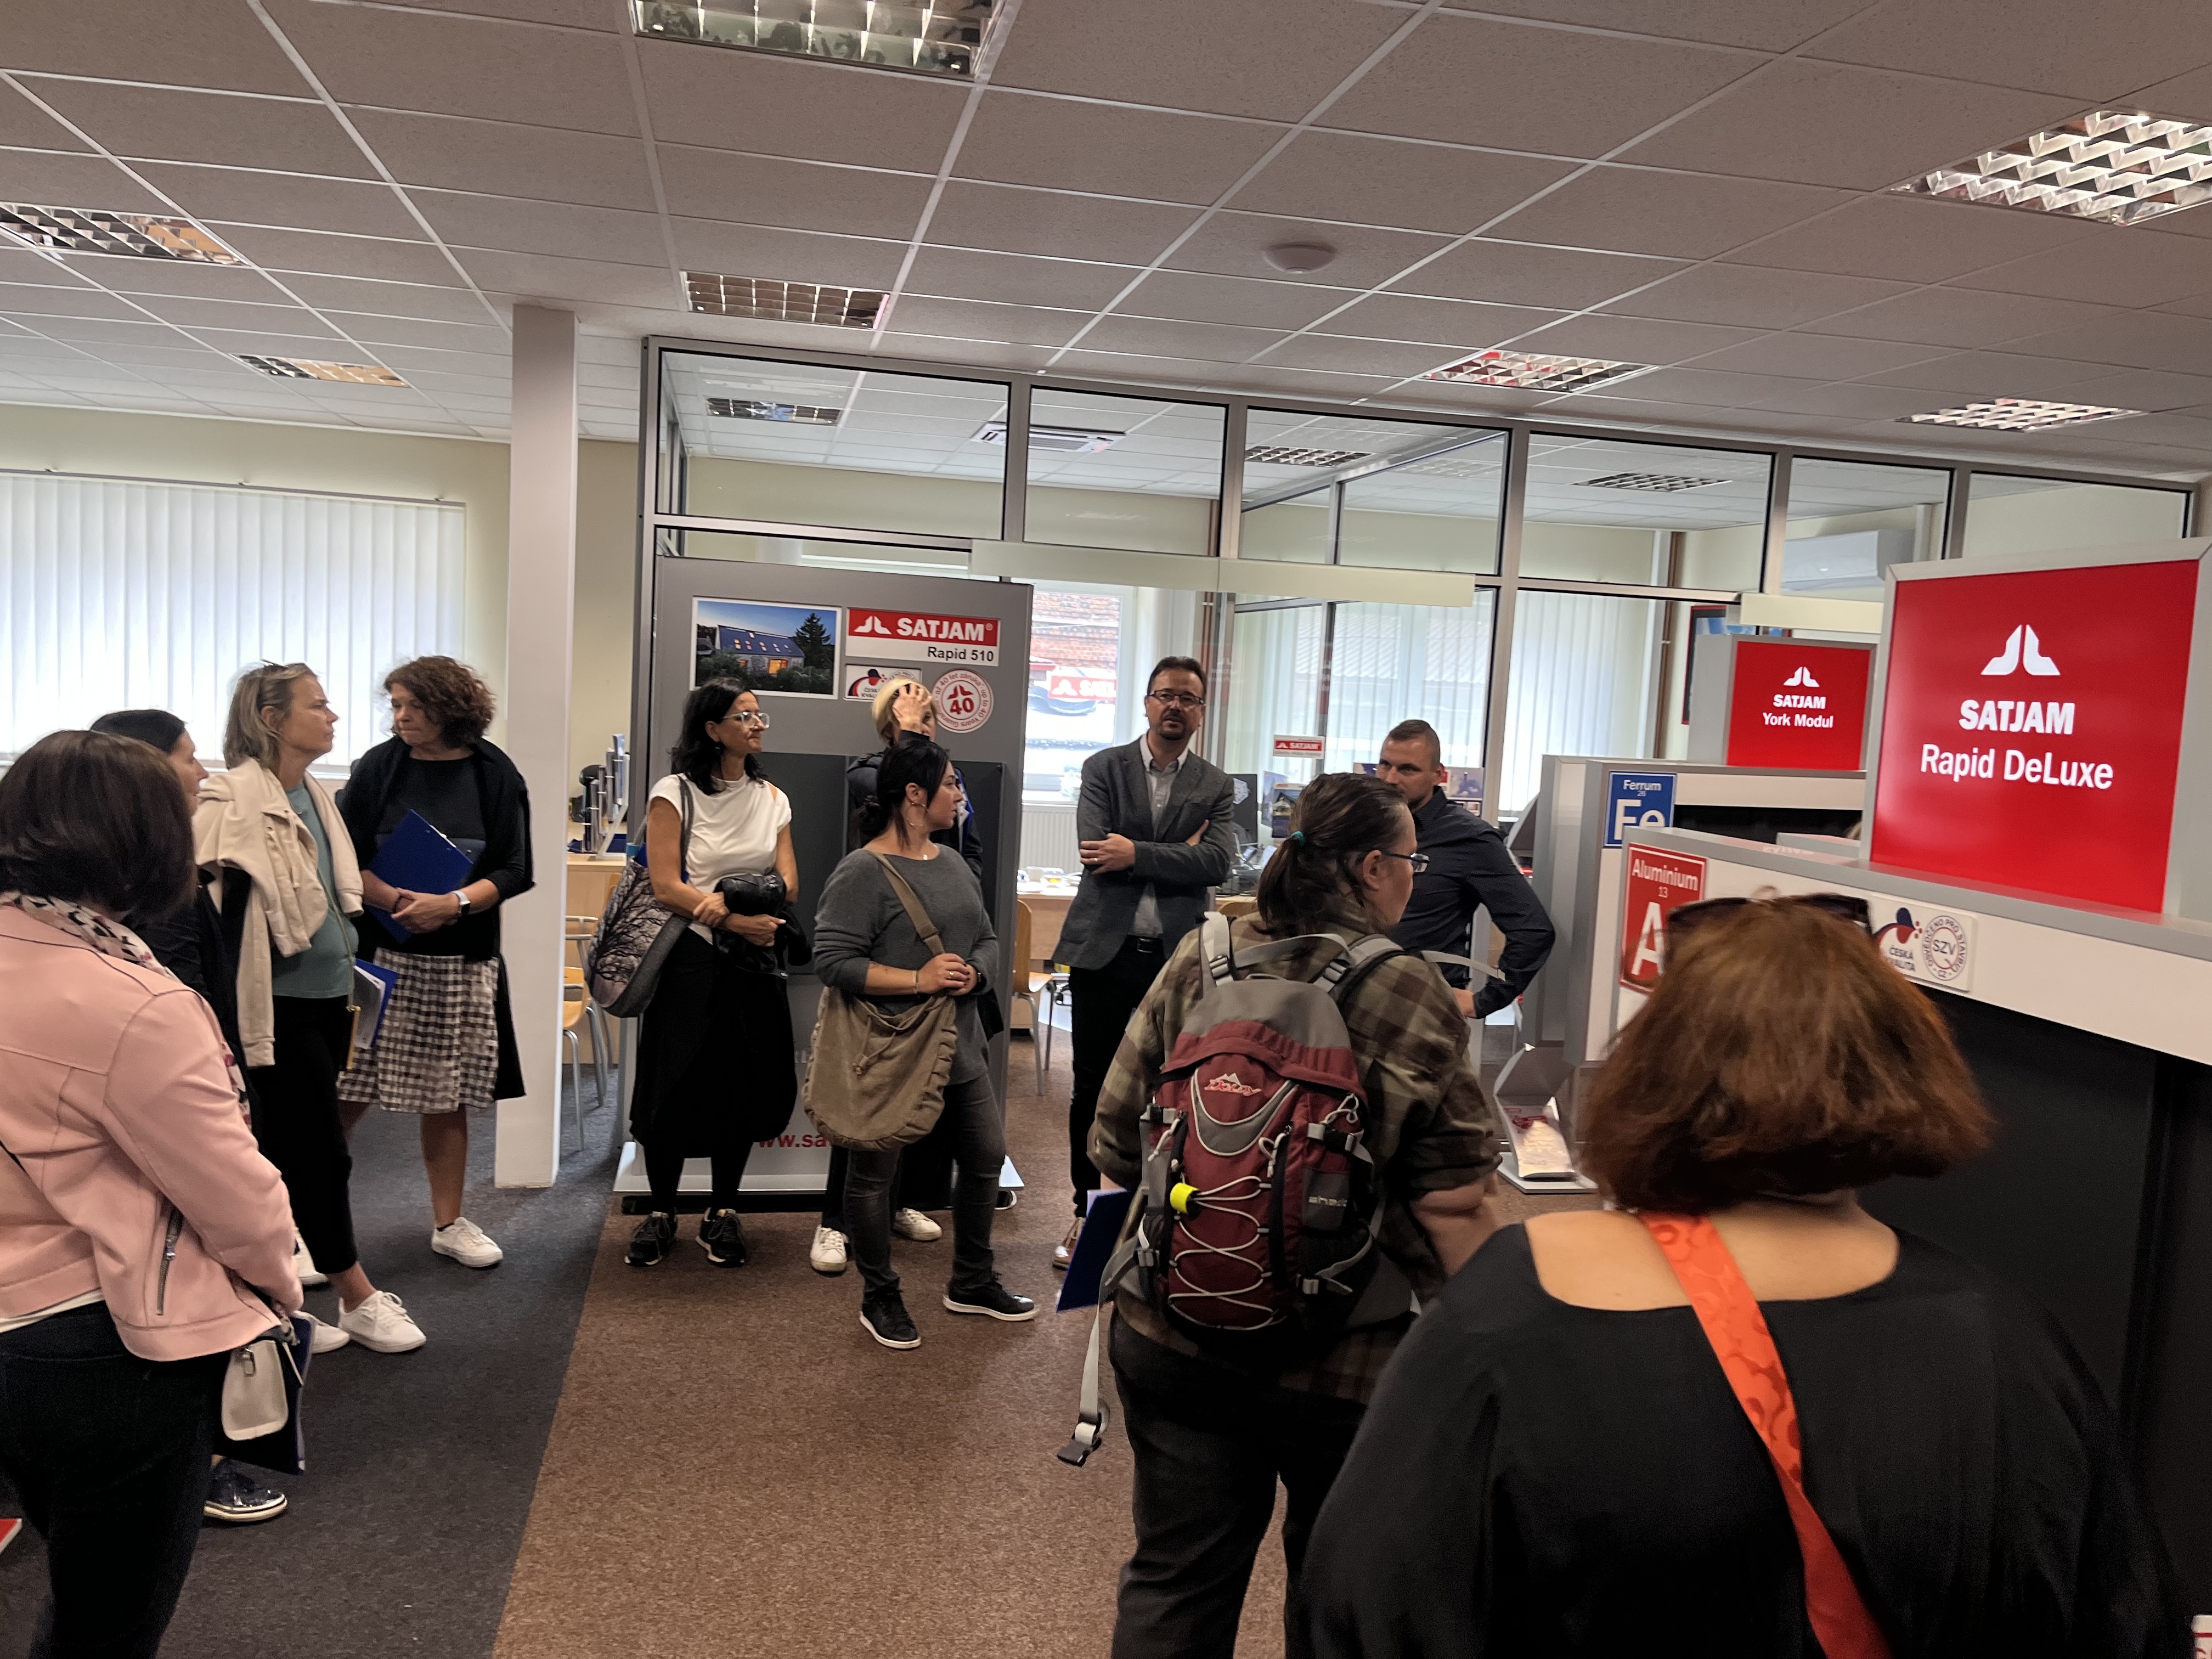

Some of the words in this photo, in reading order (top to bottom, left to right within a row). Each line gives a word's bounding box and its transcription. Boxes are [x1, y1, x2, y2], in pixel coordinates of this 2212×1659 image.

[927, 646, 967, 661] Rapid
[970, 650, 994, 662] 510
[950, 697, 974, 715] 40
[1773, 693, 1826, 709] SATJAM
[1763, 712, 1791, 727] York
[1793, 713, 1833, 729] Modul
[1959, 699, 2075, 735] SATJAM
[1920, 743, 1996, 782] Rapid
[2003, 749, 2113, 790] DeLuxe
[1623, 779, 1662, 791] Ferrum
[1614, 799, 1666, 840] Fe
[1632, 858, 1699, 891] Aluminium
[1658, 885, 1668, 899] 13
[1631, 901, 1666, 976] A
[1933, 939, 1957, 956] SZV
